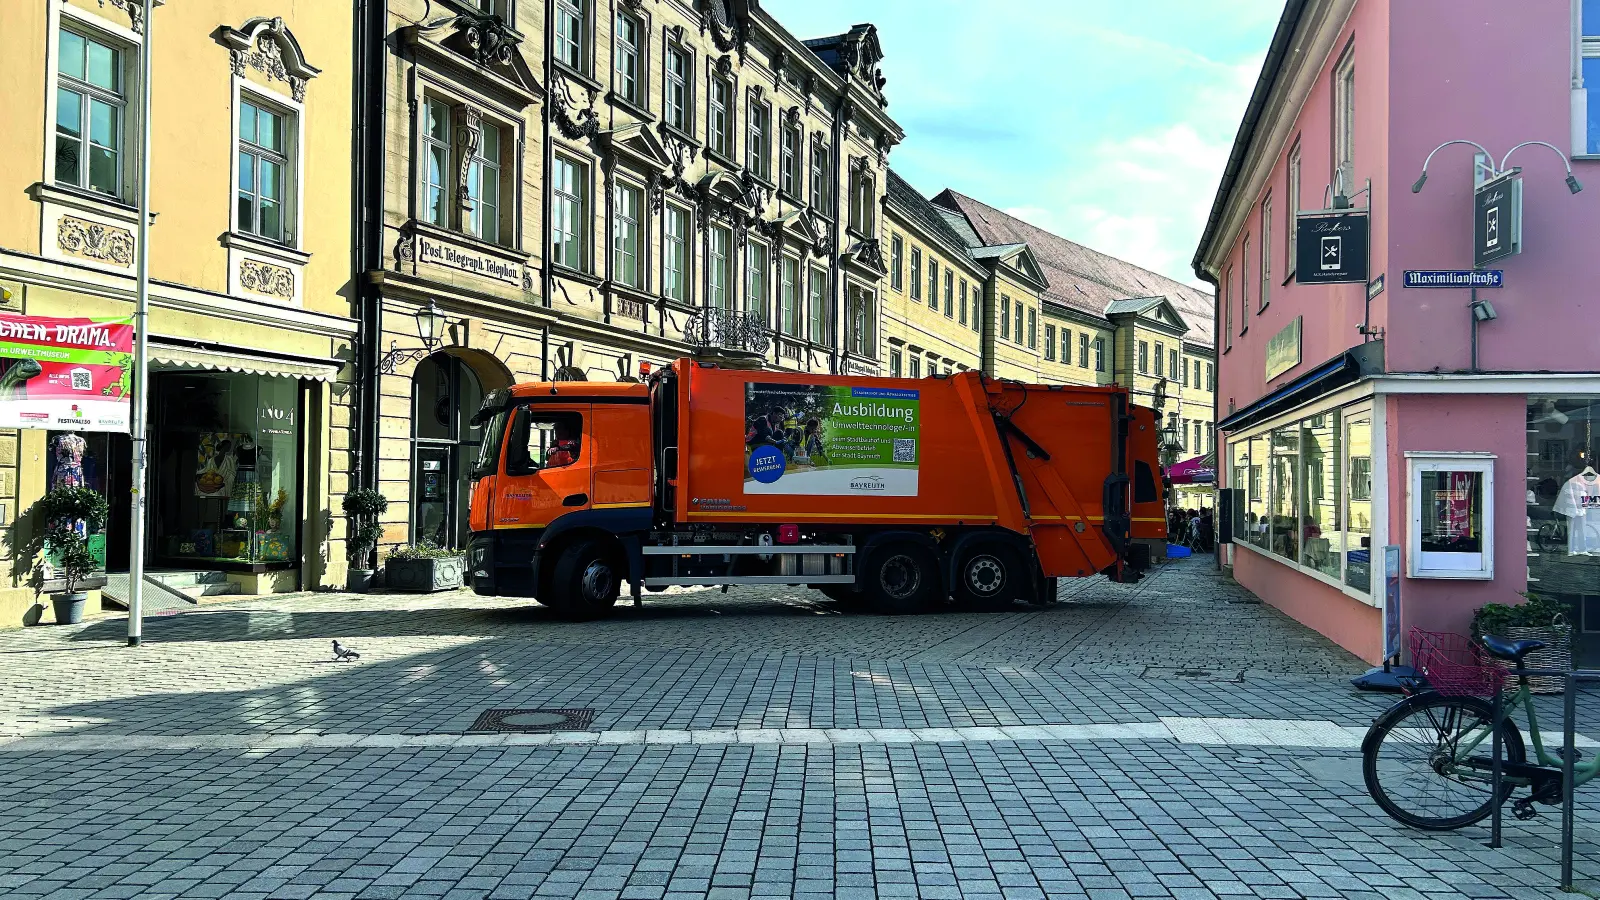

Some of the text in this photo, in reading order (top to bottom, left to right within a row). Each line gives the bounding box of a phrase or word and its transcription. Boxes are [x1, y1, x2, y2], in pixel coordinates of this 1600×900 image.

[424, 241, 443, 259] Post.
[444, 246, 484, 271] Telegraph.
[0, 320, 116, 347] CHEN. DRAMA.
[10, 347, 70, 359] URWELTMUSEUM
[832, 402, 914, 423] Ausbildung
[832, 421, 916, 432] Umwelttechnologe/-in
[756, 456, 777, 466] JETZT
